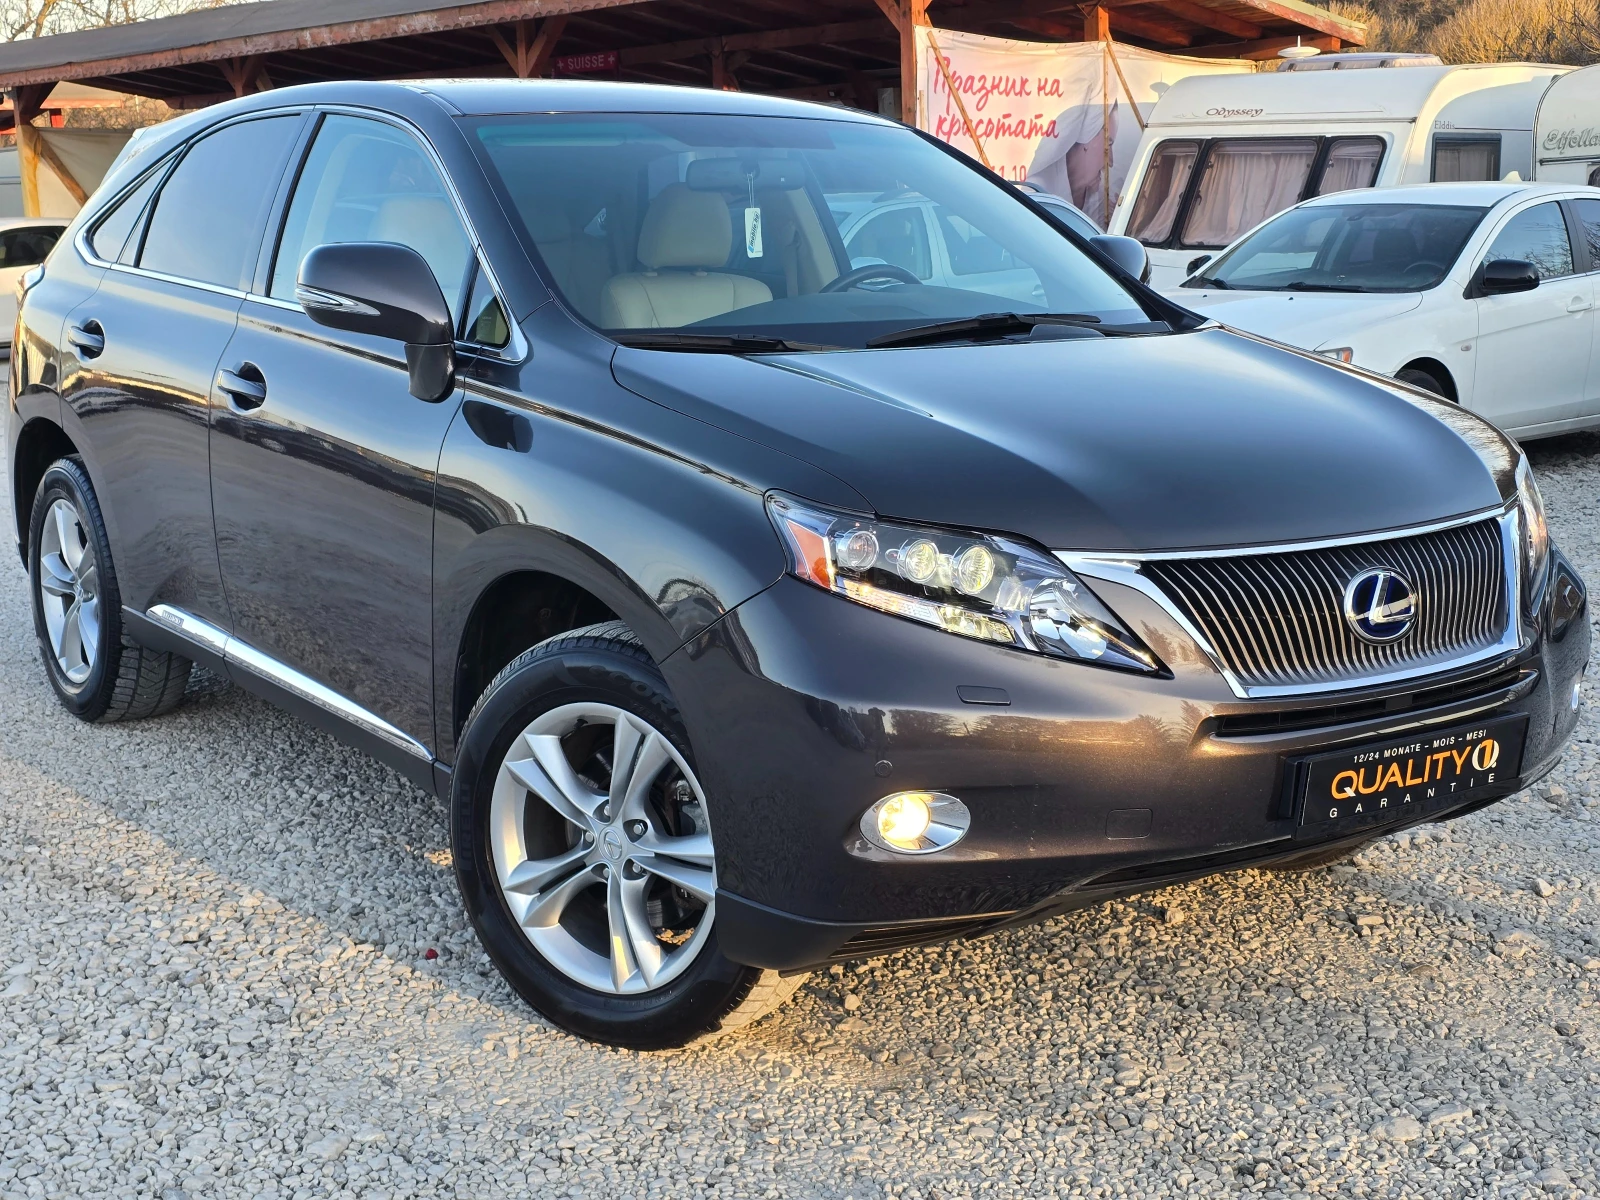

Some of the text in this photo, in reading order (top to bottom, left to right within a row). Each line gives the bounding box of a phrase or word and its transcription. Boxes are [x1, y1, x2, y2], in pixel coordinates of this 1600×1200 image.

[567, 55, 605, 70] SUISSE
[1037, 76, 1064, 98] на
[1205, 107, 1264, 118] Odyssey
[1434, 120, 1456, 130] Elddis
[1542, 127, 1600, 155] Eifella
[1353, 751, 1380, 764] 12/24
[1384, 743, 1422, 758] MONATE
[1433, 736, 1456, 749] MOIS
[1466, 729, 1487, 742] MESI
[1331, 746, 1472, 800] QUALITY
[1329, 773, 1495, 818] GARANTIE
